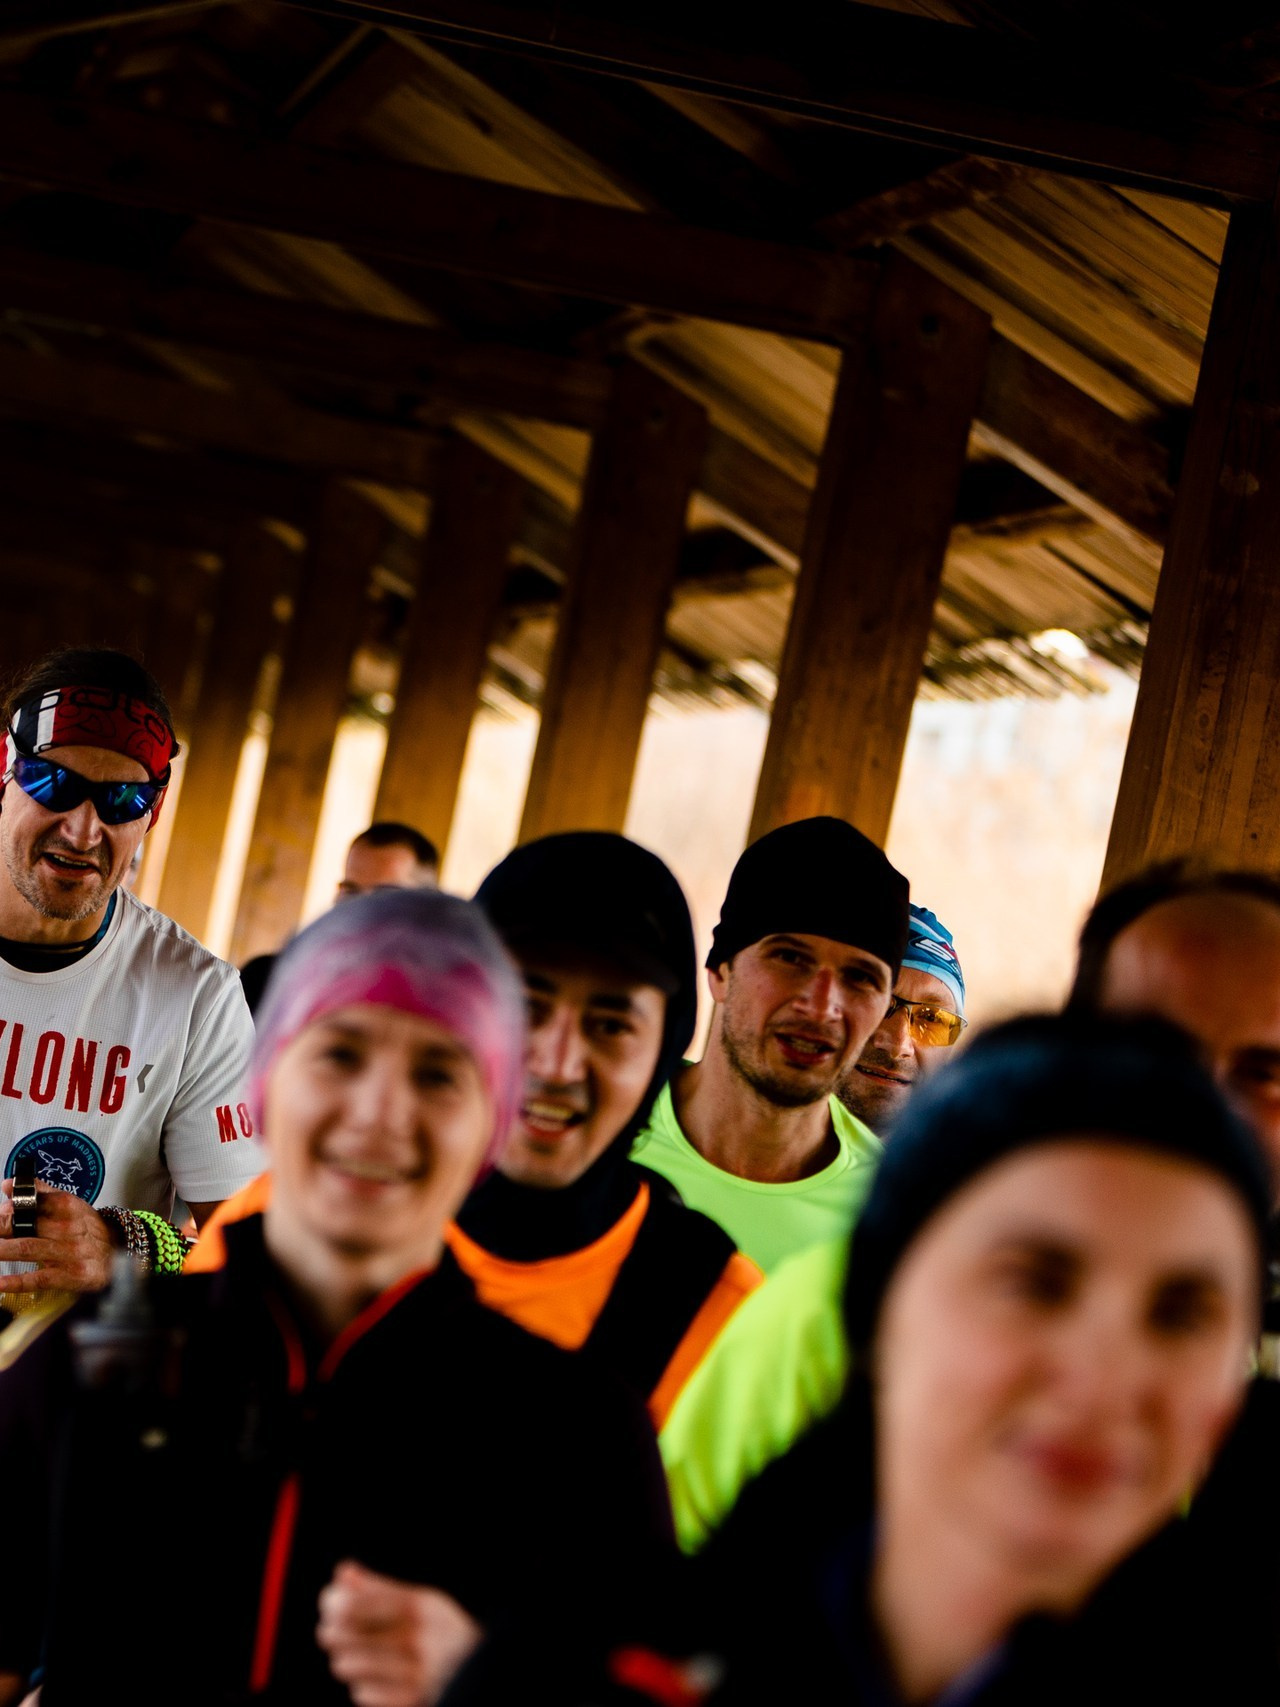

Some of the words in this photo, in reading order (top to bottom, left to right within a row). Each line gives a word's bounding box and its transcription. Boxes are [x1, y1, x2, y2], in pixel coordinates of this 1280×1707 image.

[23, 1135, 54, 1154] YEARS
[57, 1135, 70, 1143] OF
[71, 1139, 97, 1177] MADNESS
